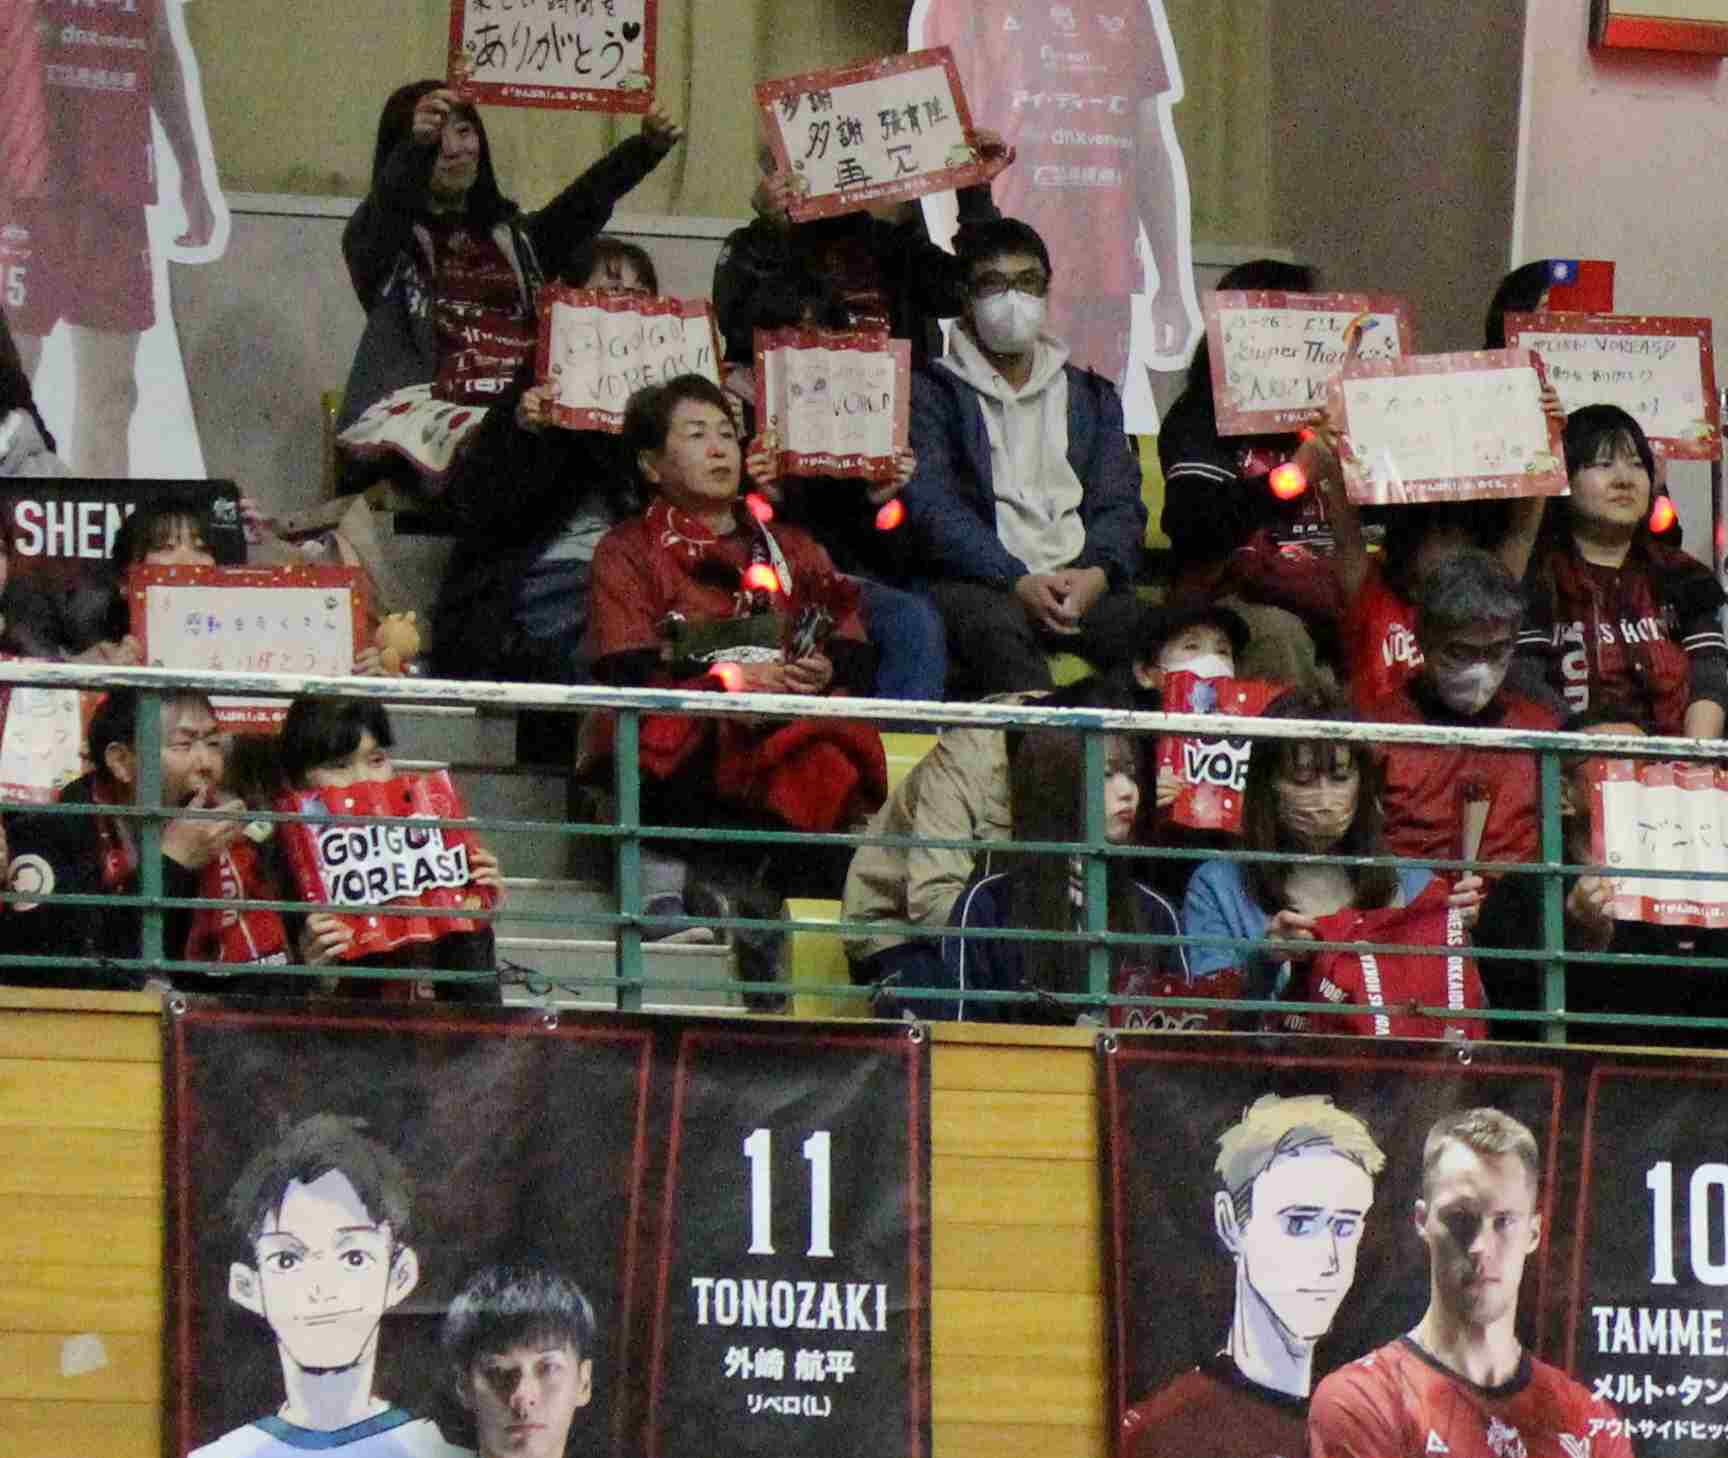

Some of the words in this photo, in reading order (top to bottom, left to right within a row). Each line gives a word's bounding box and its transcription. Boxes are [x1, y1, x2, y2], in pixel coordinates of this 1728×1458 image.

[474, 23, 623, 78] ありがとう
[805, 115, 863, 159] 多謝
[743, 1128, 834, 1258] 11
[691, 1277, 888, 1332] TONOZAKI
[794, 1349, 856, 1383] 航平
[747, 1395, 832, 1417] リベロ(L)
